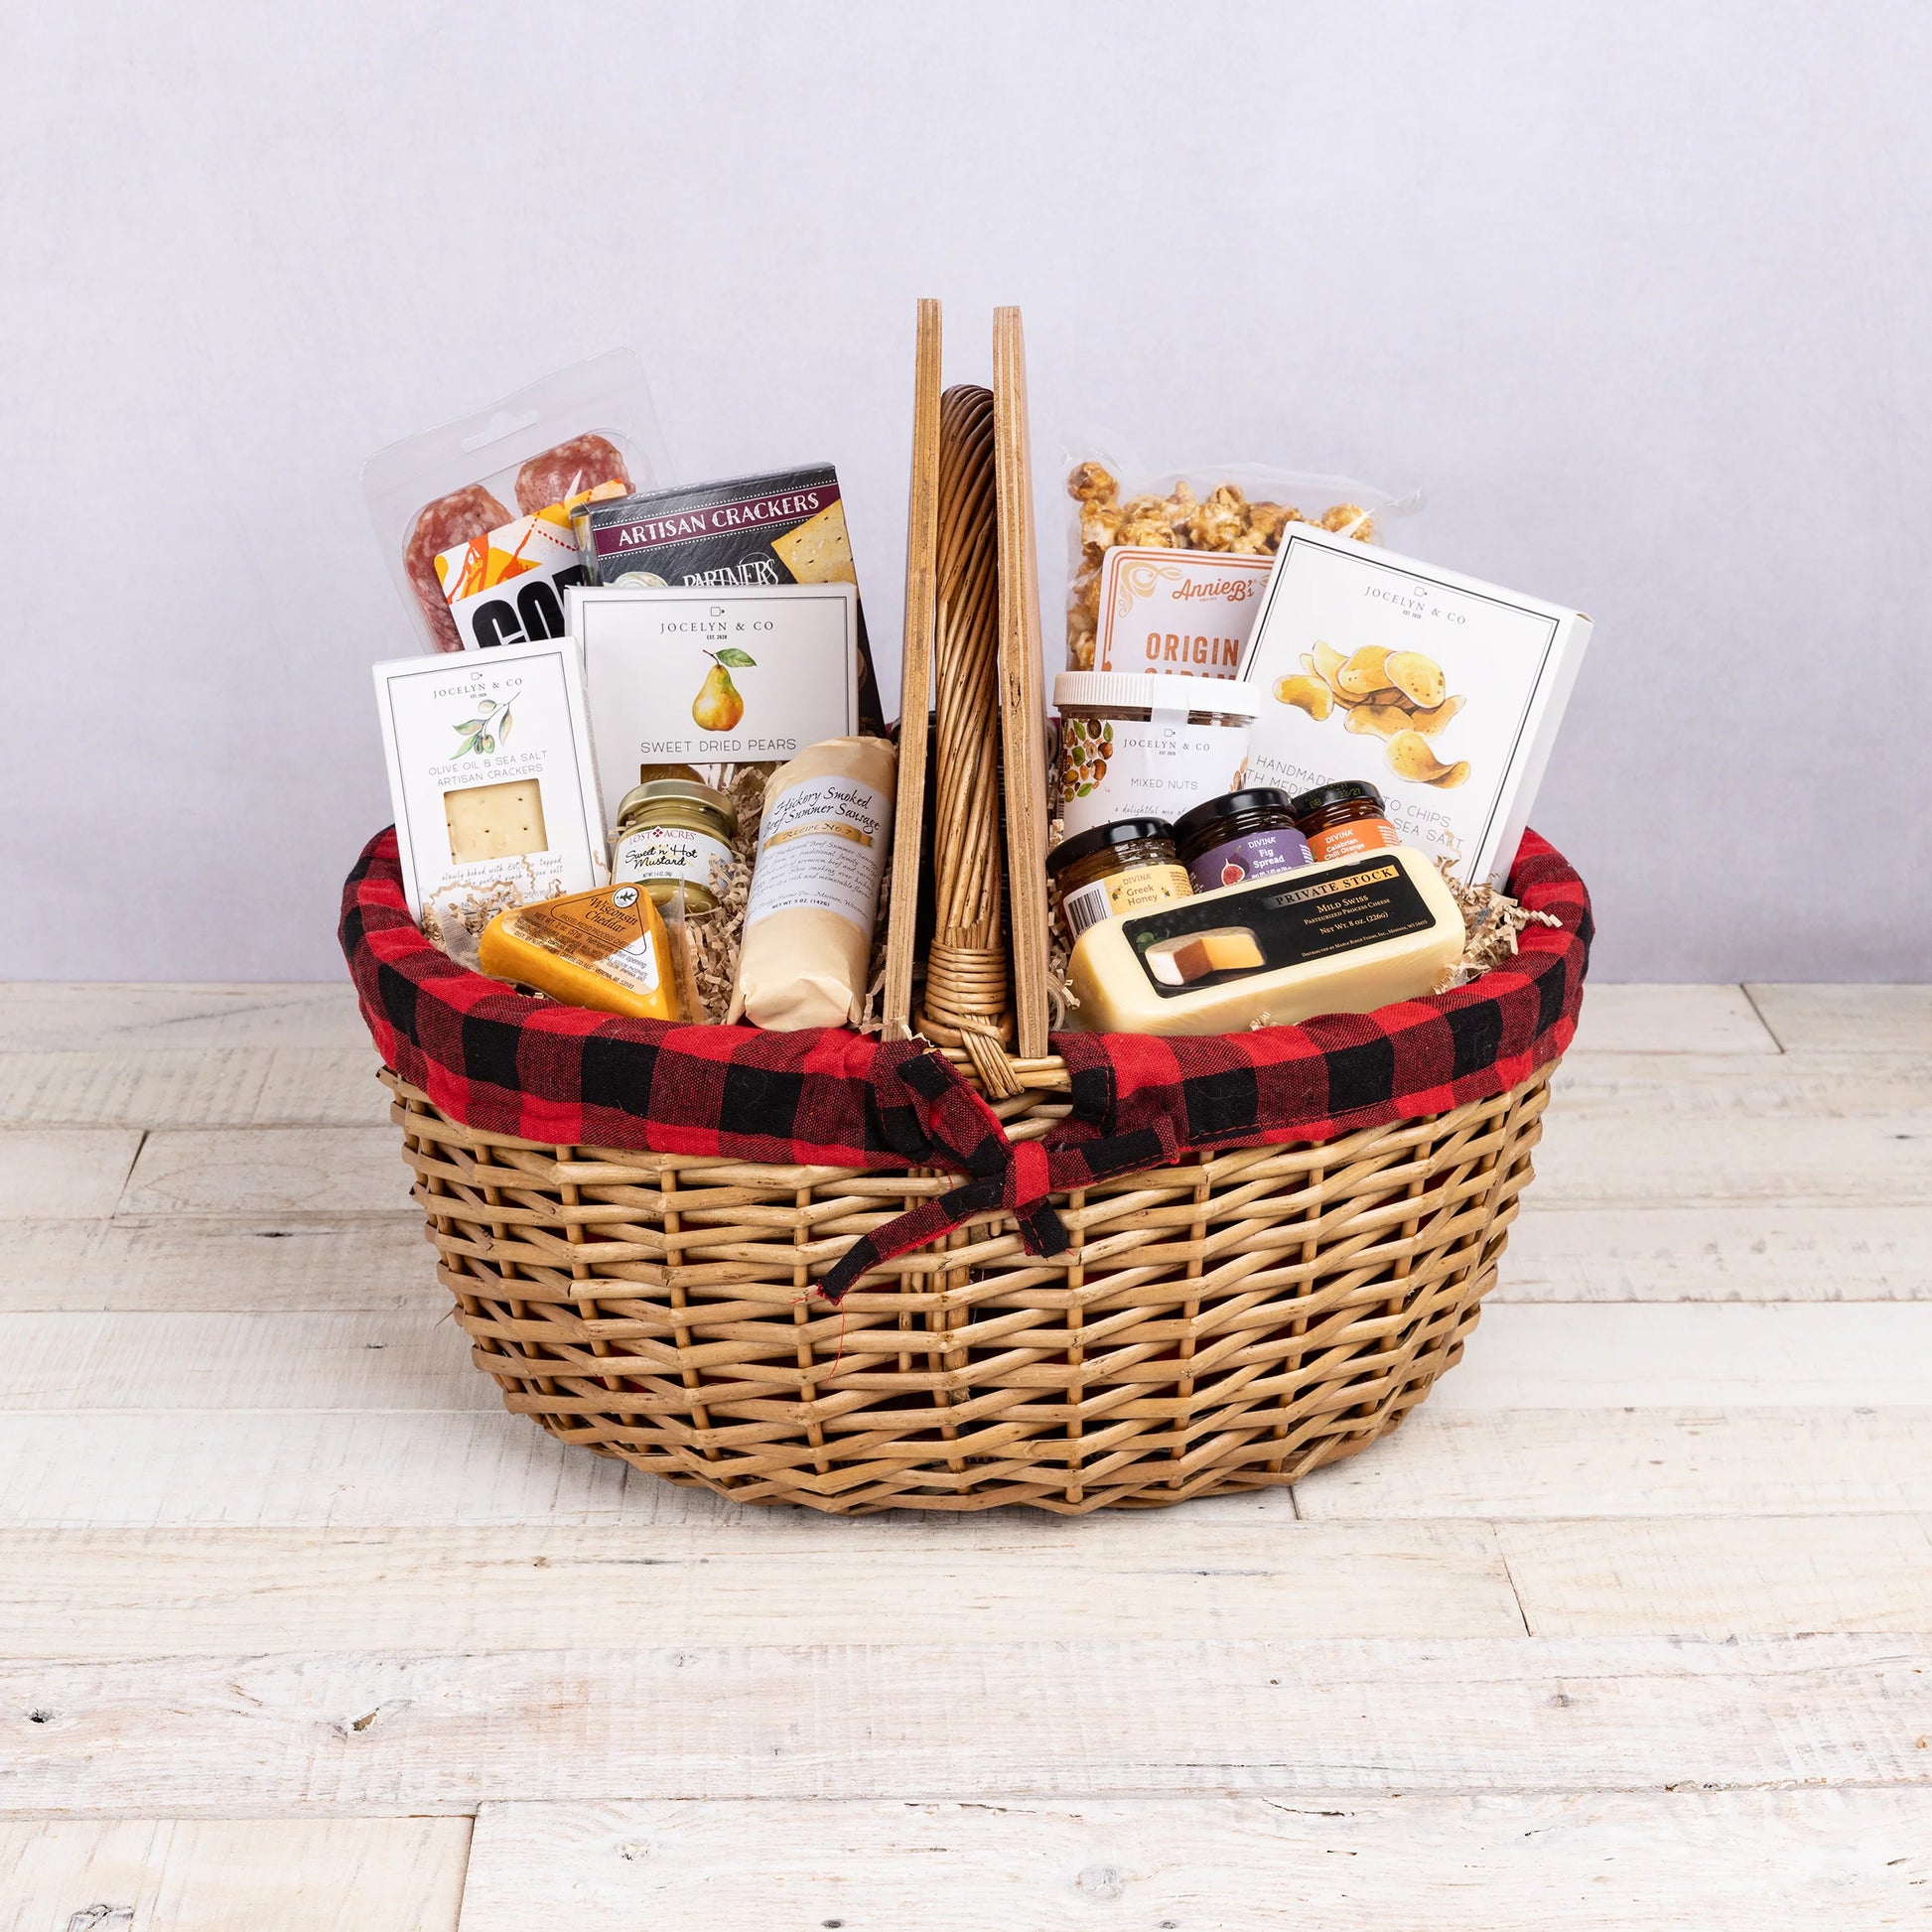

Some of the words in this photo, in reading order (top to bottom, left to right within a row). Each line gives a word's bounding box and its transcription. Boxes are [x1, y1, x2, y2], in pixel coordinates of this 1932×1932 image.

[619, 514, 707, 547] ARTISAN
[711, 492, 820, 528] CRACKERS
[472, 564, 590, 648] CO
[1364, 586, 1426, 611] JOCELYN
[1431, 608, 1441, 618] &
[1448, 612, 1466, 625] CO
[659, 621, 728, 634] JOCELYN
[736, 621, 746, 631] &
[753, 621, 774, 631] CO
[1146, 632, 1240, 667] ORIGIN
[433, 682, 486, 699] JOCELYN
[505, 677, 523, 687] CO
[640, 741, 693, 755] SWEET
[699, 740, 742, 754] DRIED
[748, 738, 797, 752] PEARS
[1123, 739, 1176, 749] JOCELYN
[1195, 743, 1210, 752] CO
[428, 763, 459, 776] OLIVE
[463, 761, 481, 770] OIL
[483, 759, 491, 767] &
[495, 756, 516, 766] SEA
[520, 750, 548, 762] SALT
[437, 773, 483, 787] ARTISAN
[486, 763, 543, 779] CRACKERS
[1246, 767, 1266, 784] TH
[1131, 778, 1164, 788] MIXED
[1168, 780, 1198, 790] NUTS
[774, 790, 821, 815] Hickory
[823, 786, 872, 809] Smoked
[1122, 803, 1159, 816] delightful
[1407, 805, 1451, 828] CHIPS
[785, 805, 834, 823] Summer
[835, 803, 881, 834] Sausage
[1393, 818, 1420, 836] SEA
[628, 831, 651, 845] LOST
[663, 830, 697, 840] ACRES
[1248, 836, 1276, 849] DIVINA
[1324, 830, 1353, 844] DIVINA
[827, 842, 855, 854] Summer
[1259, 848, 1275, 858] Fig
[1325, 838, 1358, 853] Calabrian
[1340, 843, 1365, 854] Orange
[624, 846, 656, 864] Sweet
[669, 844, 698, 859] Hot
[837, 854, 860, 867] family
[1253, 855, 1285, 869] Spread
[634, 857, 687, 870] Mustard
[828, 859, 842, 869] beef
[819, 875, 853, 889] memorable
[1123, 874, 1152, 886] DIVINA
[1276, 882, 1339, 905] PRIVATE
[1343, 868, 1393, 888] STOCK
[1126, 885, 1155, 897] Greek
[1128, 894, 1158, 905] Honey
[590, 897, 638, 925] Wisconsin
[559, 912, 592, 933] PASTEURIZED
[592, 926, 615, 942] PROCESS
[585, 910, 626, 933] Cheddar
[533, 911, 546, 921] NET
[587, 936, 615, 953] Refrigerate
[626, 956, 647, 970] opening
